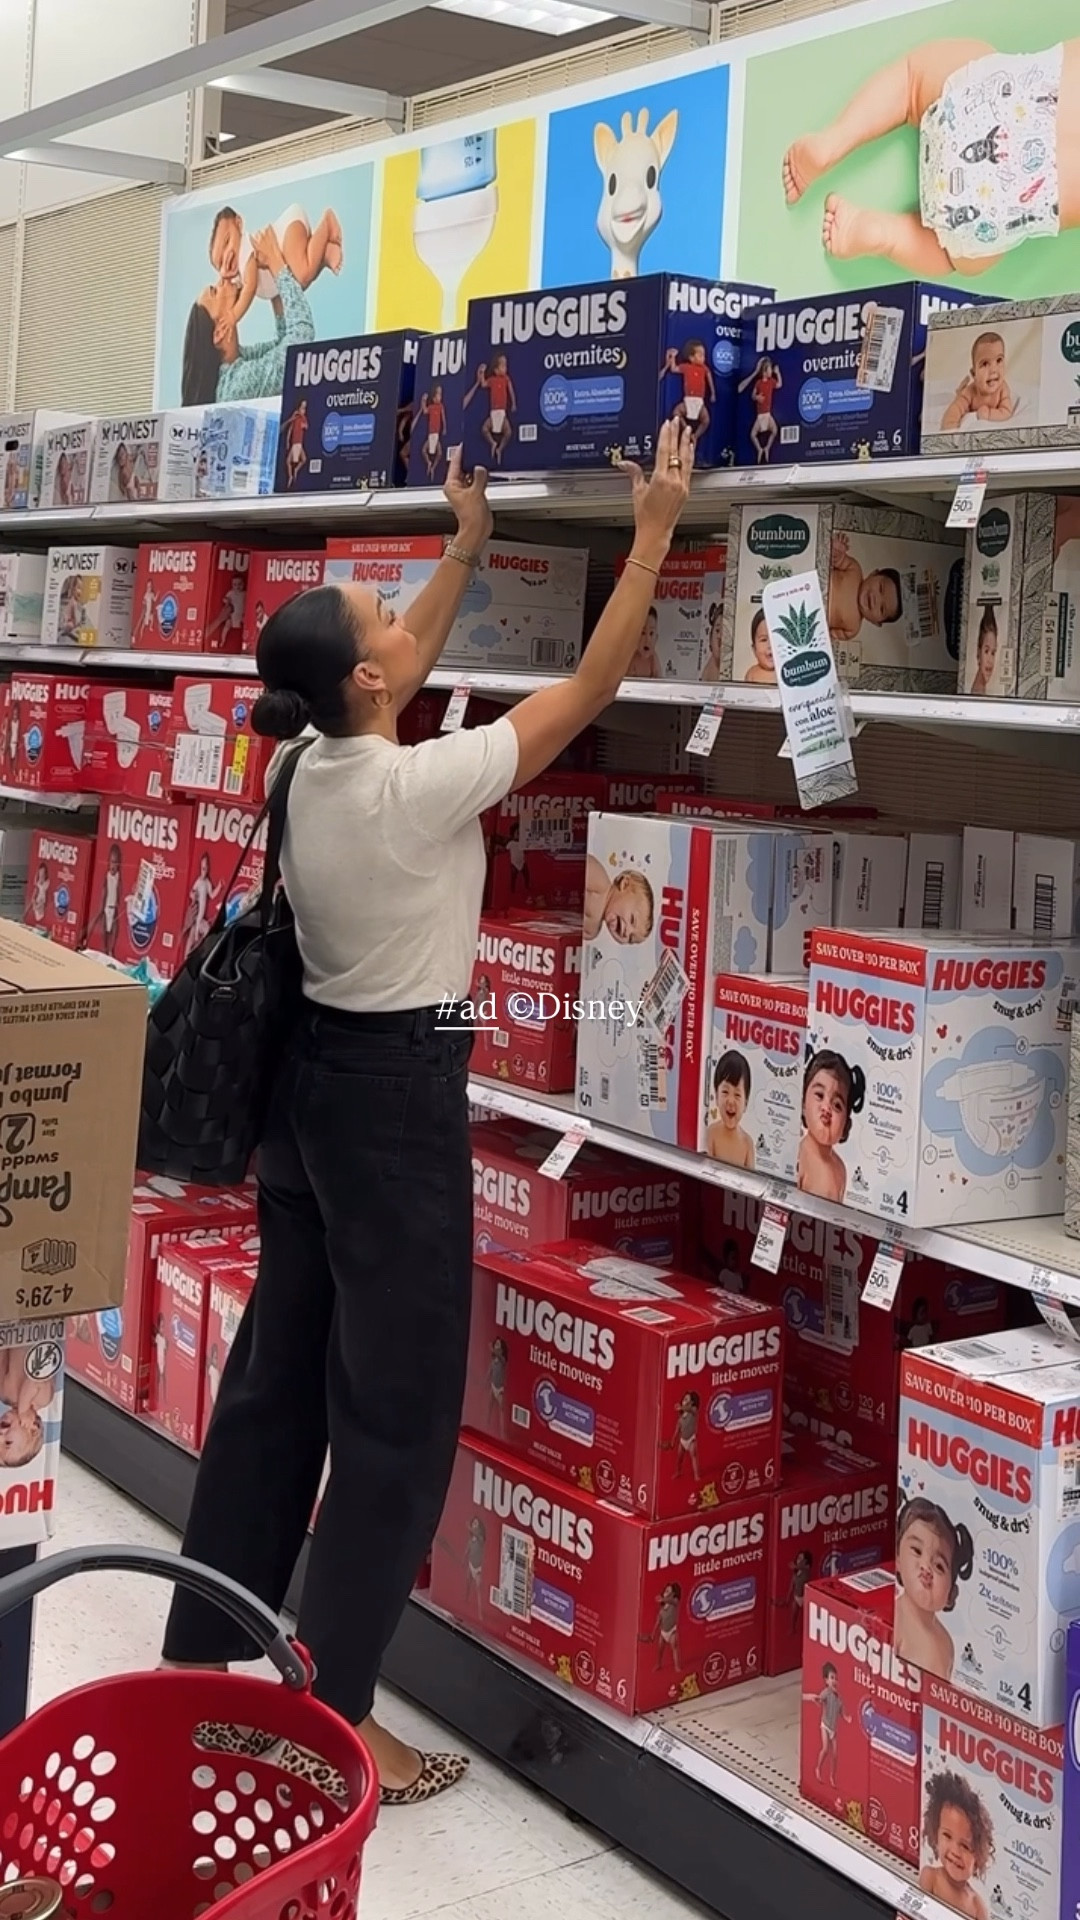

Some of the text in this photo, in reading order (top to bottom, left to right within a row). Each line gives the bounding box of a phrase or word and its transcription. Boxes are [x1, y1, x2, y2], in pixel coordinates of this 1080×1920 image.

[490, 290, 627, 345] HUGGIES
[294, 345, 383, 388] HUGGIES
[544, 347, 622, 370] overnites
[327, 387, 377, 408] overnites
[543, 391, 568, 405] 100%
[801, 394, 824, 405] 100%
[4, 422, 31, 438] HONEST
[55, 428, 86, 451] HONEST
[112, 419, 159, 442] HONEST
[644, 435, 652, 450] 5
[893, 428, 901, 444] 6
[751, 525, 806, 541] bumbum
[60, 552, 99, 571] HONEST
[149, 550, 197, 573] HUGGIES
[266, 558, 320, 583] HUGGIES
[352, 562, 403, 582] HUGGIES
[489, 553, 549, 575] HUGGIES
[783, 658, 828, 678] bumbum
[11, 681, 49, 703] HUGGIES
[107, 805, 179, 851] HUGGIES
[38, 837, 79, 866] HUGGIES
[691, 908, 700, 938] SAVE
[474, 932, 555, 976] HUGGIES
[690, 940, 699, 983] OVER
[816, 942, 838, 958] SAVE
[840, 947, 864, 965] OVER
[879, 955, 897, 971] PER
[502, 970, 554, 993] little movers
[932, 958, 1047, 991] HUGGIES
[719, 988, 739, 1004] SAVE
[739, 993, 762, 1007] OVER
[774, 1001, 792, 1016] PER
[816, 980, 916, 1035] HUGGIES
[993, 1000, 1042, 1021] snug & dry
[687, 1003, 697, 1032] PER
[726, 1014, 800, 1056] HUGGIES
[867, 1036, 913, 1061] snug & dry
[16, 1062, 82, 1084] Format
[538, 1061, 547, 1077] 6
[10, 1080, 73, 1107] Jumbo
[580, 1092, 592, 1107] 5
[877, 1082, 903, 1100] 100%
[5, 1116, 29, 1155] 2
[42, 1118, 58, 1127] Taille
[42, 1129, 56, 1138] Size
[572, 1182, 680, 1221] HUGGIES
[897, 1190, 909, 1215] 4
[494, 1211, 530, 1239] movers
[614, 1211, 680, 1231] little movers
[157, 1254, 202, 1307] HUGGIES
[16, 1282, 74, 1308] 4-29's
[26, 1323, 48, 1342] NOT
[50, 1321, 64, 1339] DO
[496, 1283, 615, 1371] HUGGIES
[666, 1325, 781, 1380] HUGGIES
[529, 1344, 603, 1392] little movers
[711, 1360, 781, 1387] little movers
[876, 1401, 885, 1420] 4
[904, 1371, 933, 1396] SAVE
[934, 1382, 965, 1409] OVER
[966, 1395, 983, 1414] $10
[983, 1401, 1007, 1425] PER
[764, 1458, 774, 1479] 6
[908, 1416, 1032, 1504] HUGGIES
[0, 1478, 54, 1514] HU
[637, 1484, 647, 1504] 6
[473, 1460, 594, 1562] HUGGIES
[781, 1484, 890, 1540] HUGGIES
[973, 1496, 1030, 1534] snug & dry
[648, 1512, 765, 1572] HUGGIES
[824, 1517, 889, 1544] little movers
[538, 1546, 583, 1583] movers
[693, 1547, 764, 1577] little movers
[987, 1548, 1019, 1576] 100%
[979, 1582, 992, 1601] 2x
[746, 1646, 757, 1667] 6
[809, 1601, 922, 1693] HUGGIES
[616, 1679, 627, 1699] 6
[999, 1680, 1014, 1697] 136
[1017, 1682, 1032, 1712] 4
[930, 1682, 1065, 1759] SAVE OVER $10 PER BOX
[939, 1717, 1054, 1804] HUGGIES
[999, 1792, 1052, 1831] snug & dry
[908, 1825, 919, 1849] 8
[1015, 1839, 1044, 1865] 100%
